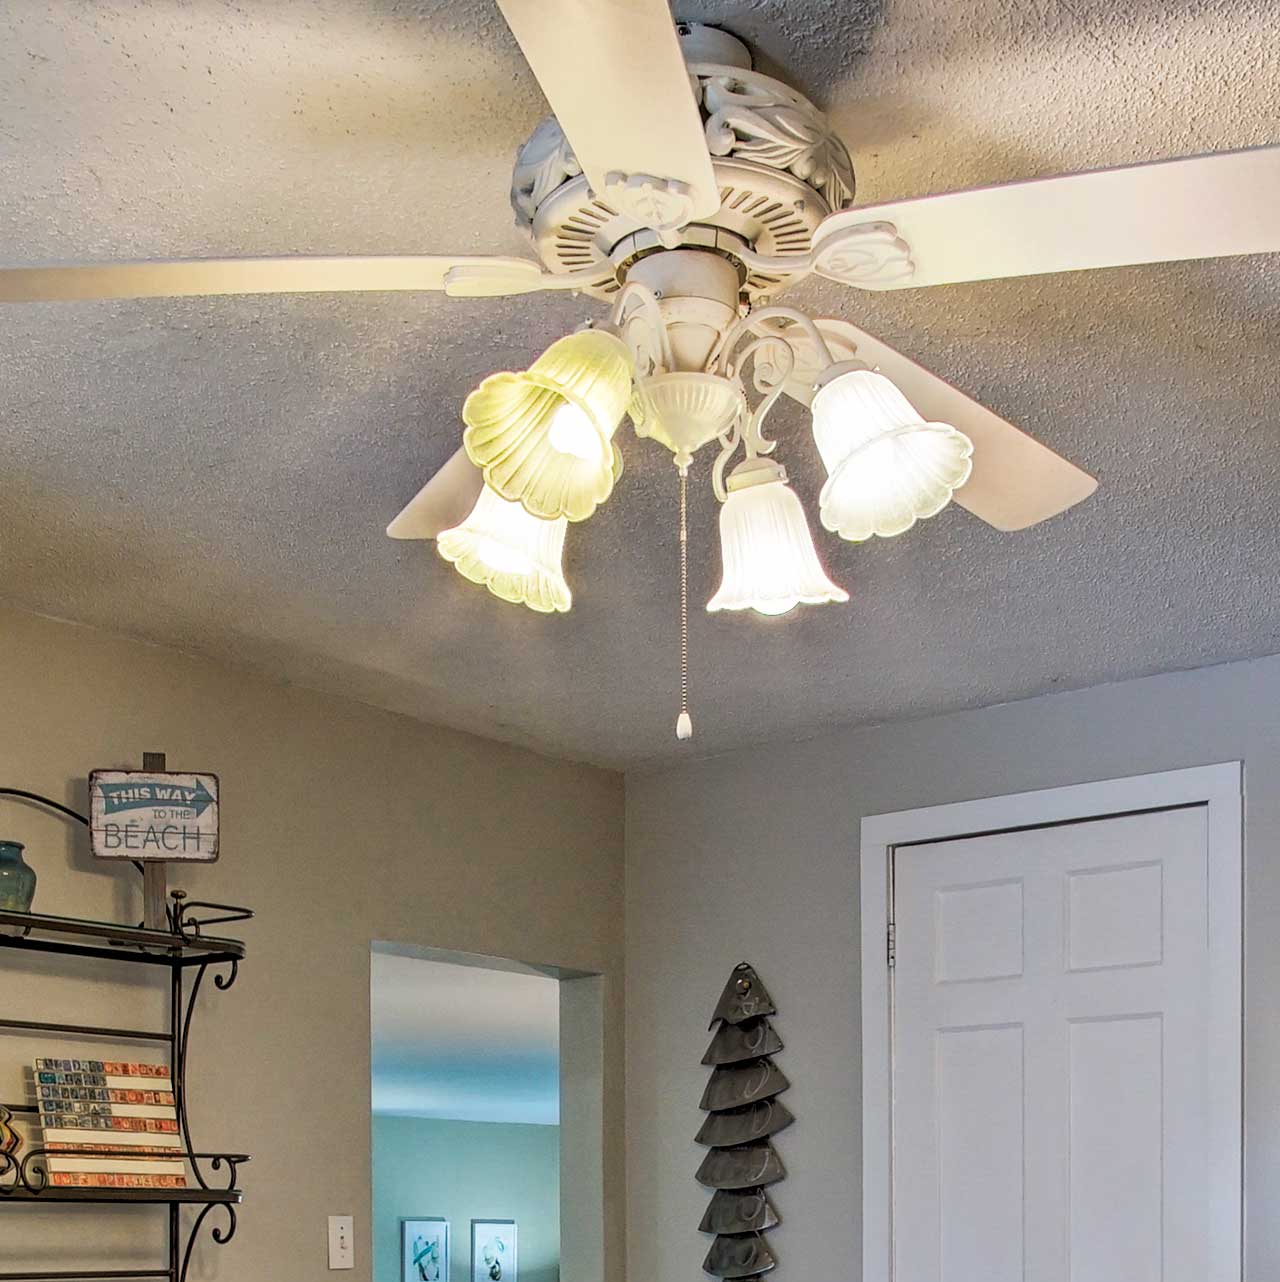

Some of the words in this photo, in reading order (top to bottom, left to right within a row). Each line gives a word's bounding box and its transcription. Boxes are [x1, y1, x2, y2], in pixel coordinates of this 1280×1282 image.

[109, 787, 151, 805] THIS
[155, 787, 196, 804] WAY
[152, 808, 166, 819] TO
[170, 809, 191, 820] THE
[103, 823, 200, 851] BEACH
